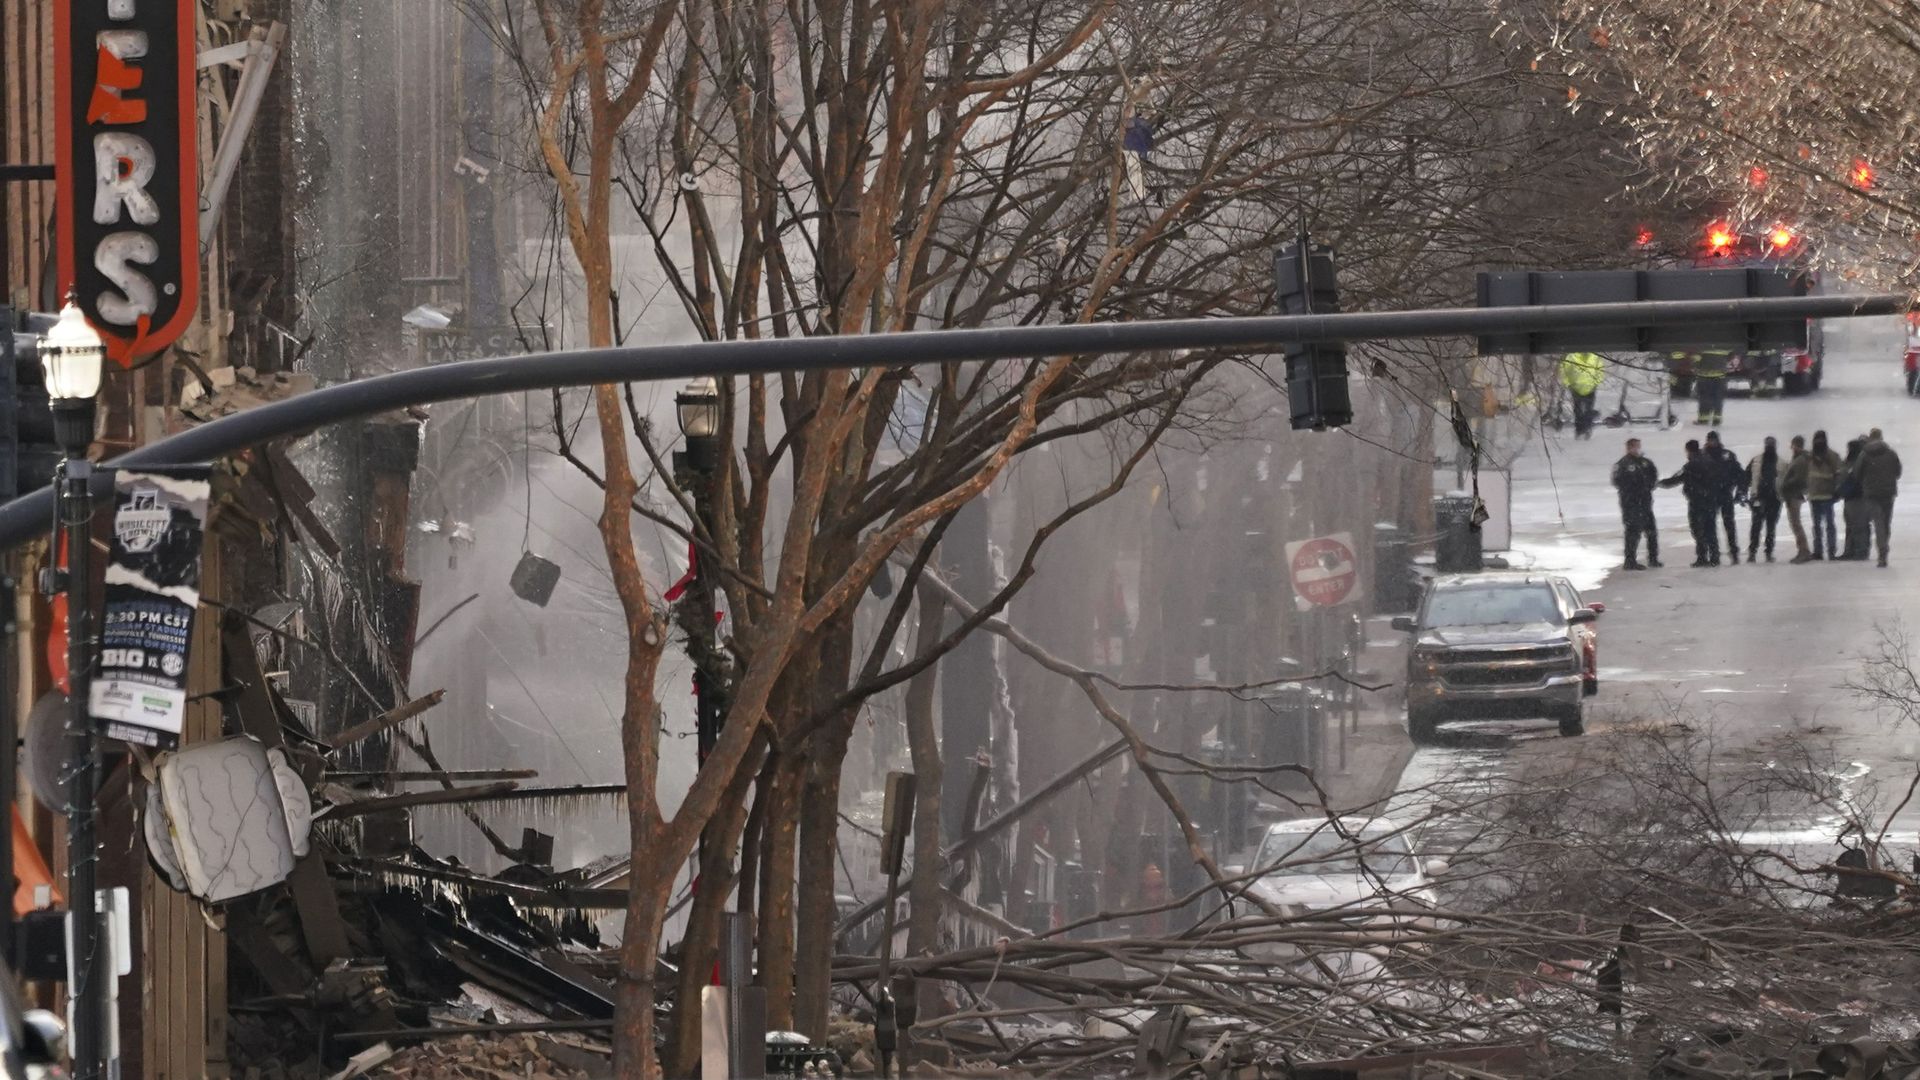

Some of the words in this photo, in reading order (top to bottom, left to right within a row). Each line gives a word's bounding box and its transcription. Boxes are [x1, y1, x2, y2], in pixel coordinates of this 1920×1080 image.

[86, 0, 160, 326] ERS
[118, 520, 145, 530] MUSIC
[146, 519, 167, 532] CITY
[127, 529, 155, 538] BOWL
[1308, 579, 1345, 596] ENTER
[139, 612, 162, 624] PM
[163, 614, 190, 629] CST
[144, 623, 188, 638] STADIUM
